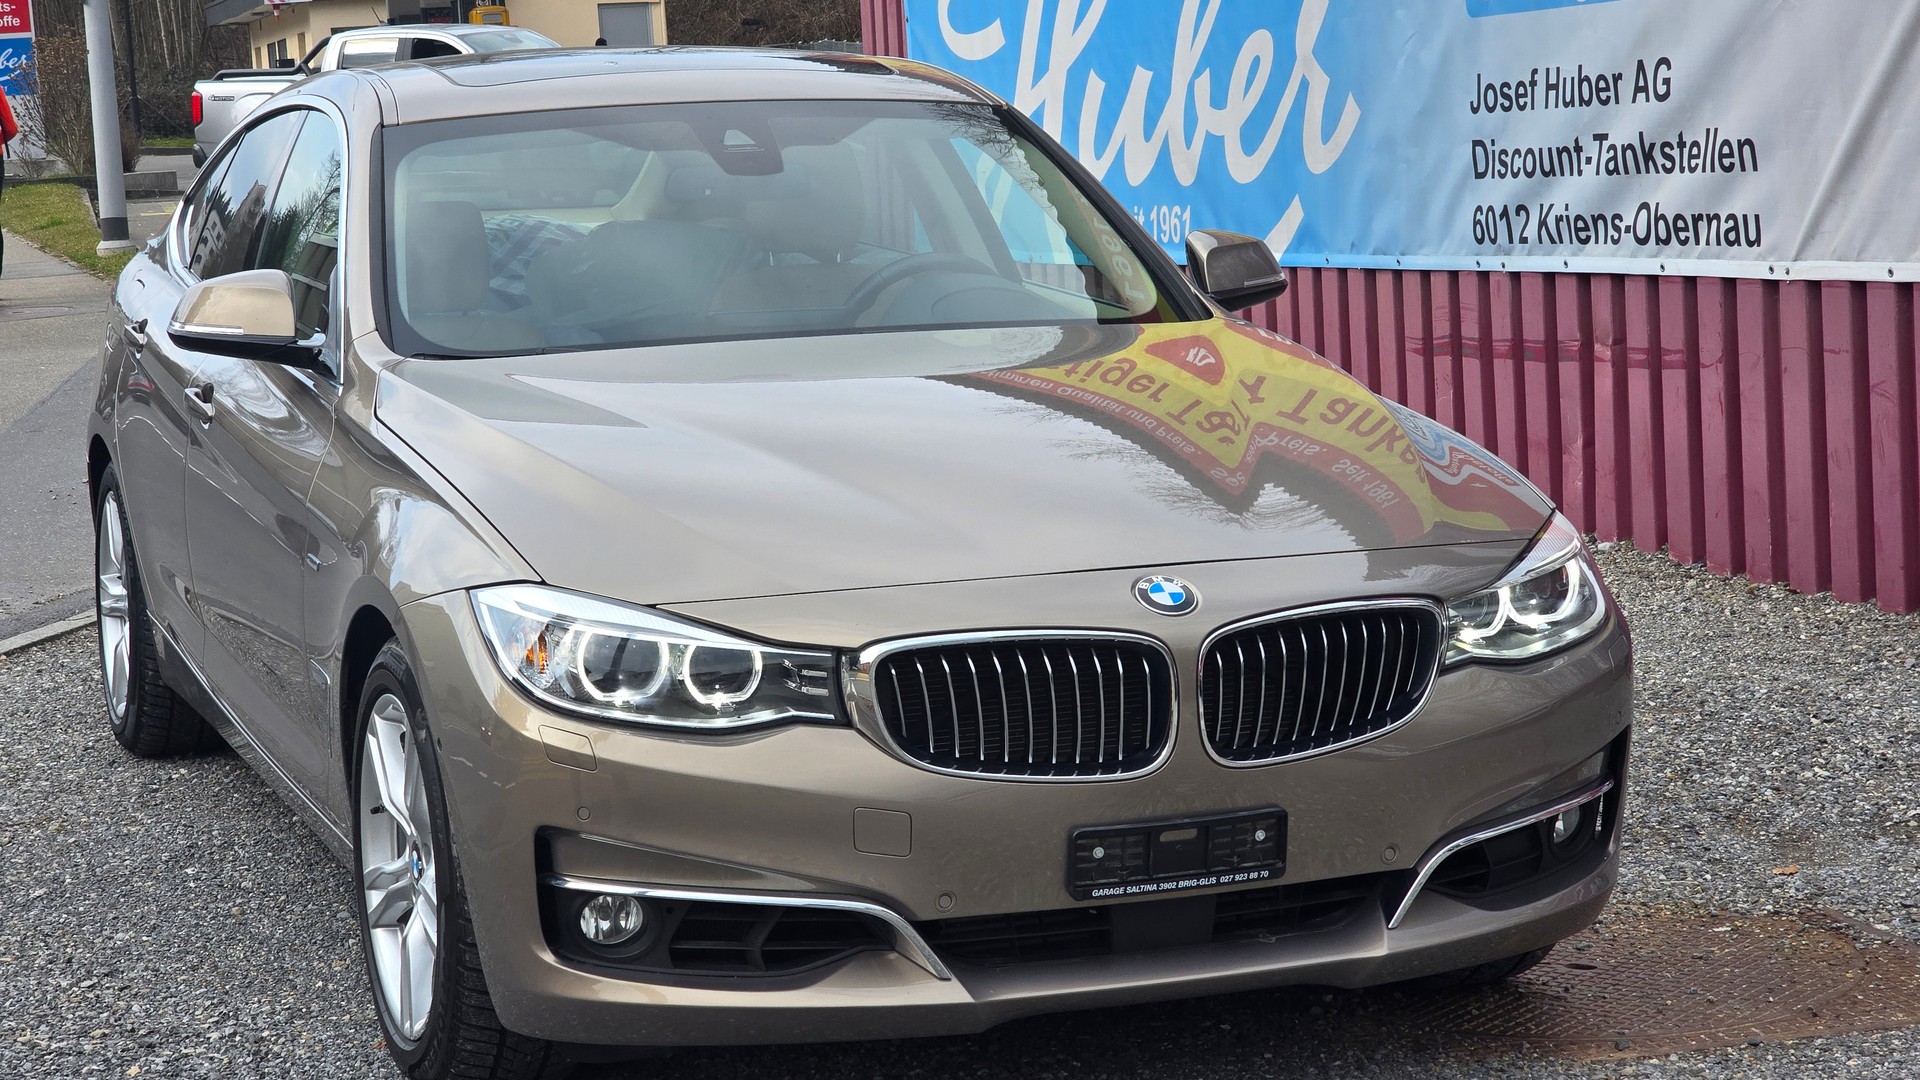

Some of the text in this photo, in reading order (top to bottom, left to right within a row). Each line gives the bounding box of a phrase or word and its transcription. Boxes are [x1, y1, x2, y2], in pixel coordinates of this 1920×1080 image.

[1470, 56, 1672, 114] Josef Huber AG
[1471, 127, 1758, 180] Discount-Tankstellen
[1150, 204, 1191, 244] 1961
[1472, 201, 1762, 248] 6012 Kriens-Obernau
[1138, 576, 1185, 590] BMW
[1092, 870, 1269, 897] GARAGE SALTINA 3902 BRIG-GLIS 027 923 88 70
